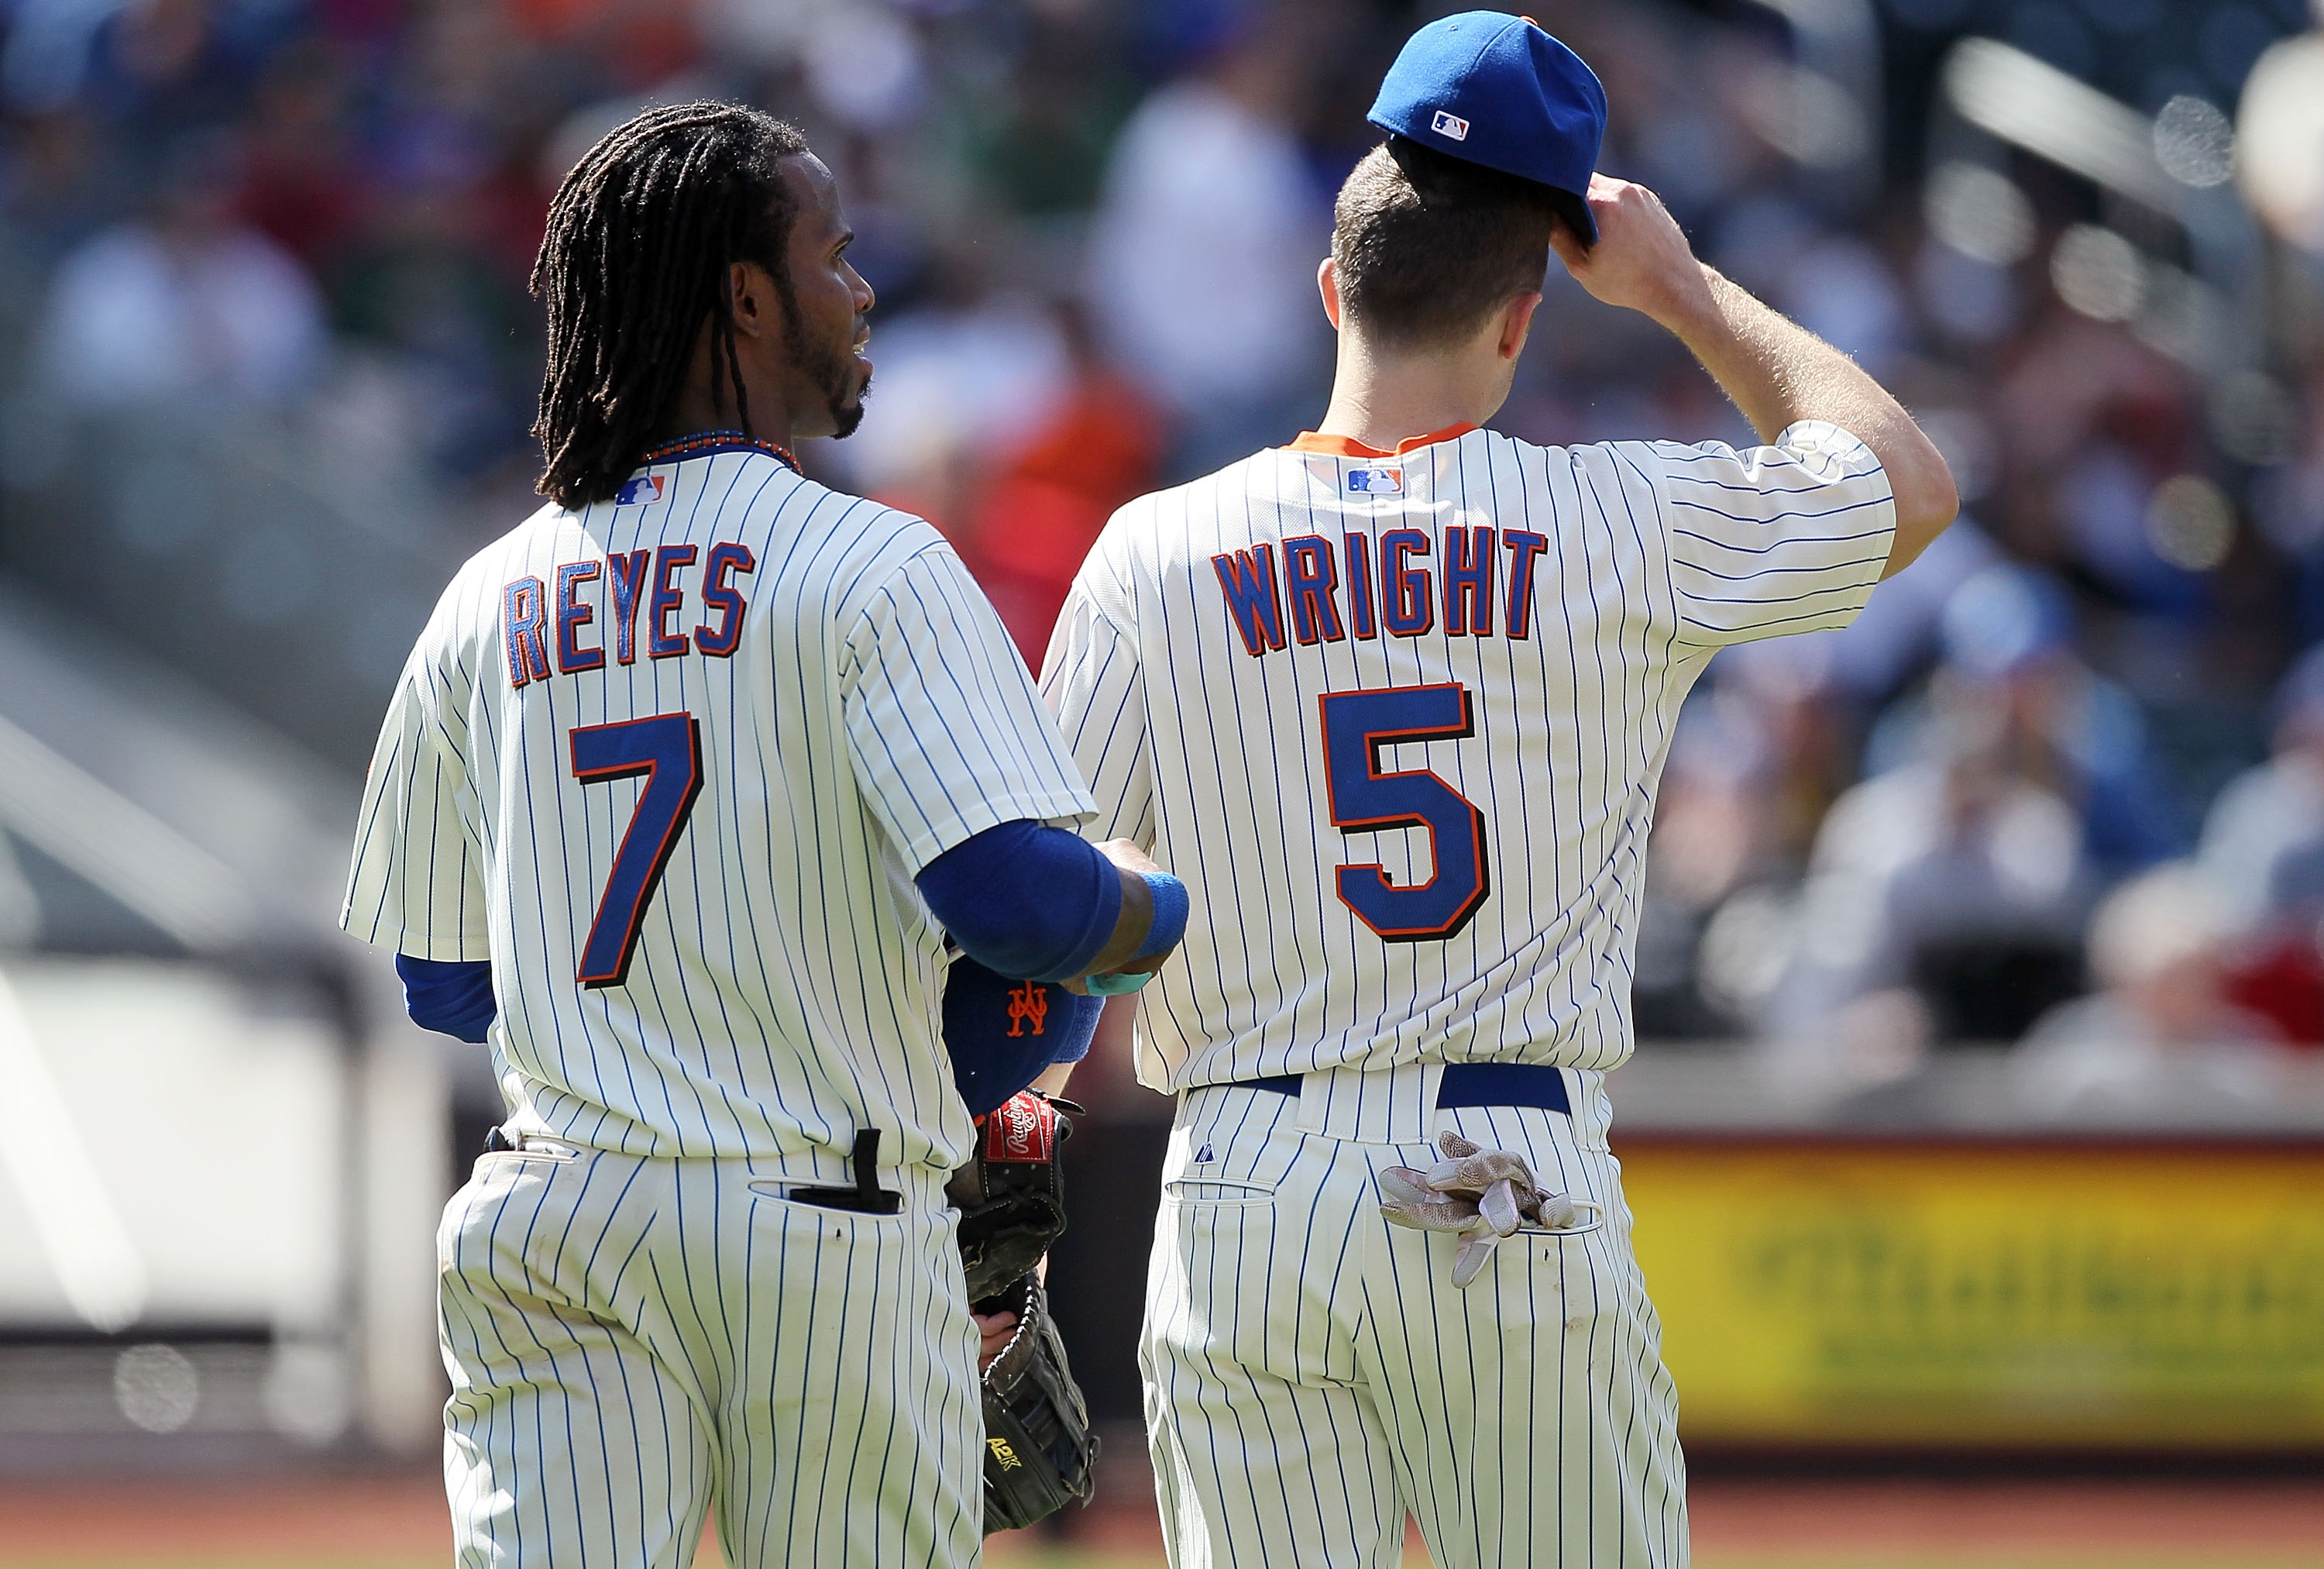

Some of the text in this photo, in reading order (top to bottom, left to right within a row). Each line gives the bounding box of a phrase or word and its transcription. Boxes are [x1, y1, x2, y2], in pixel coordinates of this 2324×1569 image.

[504, 542, 755, 690] REYES
[1211, 526, 1548, 656] WRIGHT
[569, 711, 704, 990] 7
[1318, 682, 1490, 943] 5
[986, 1438, 1022, 1471] A2K
